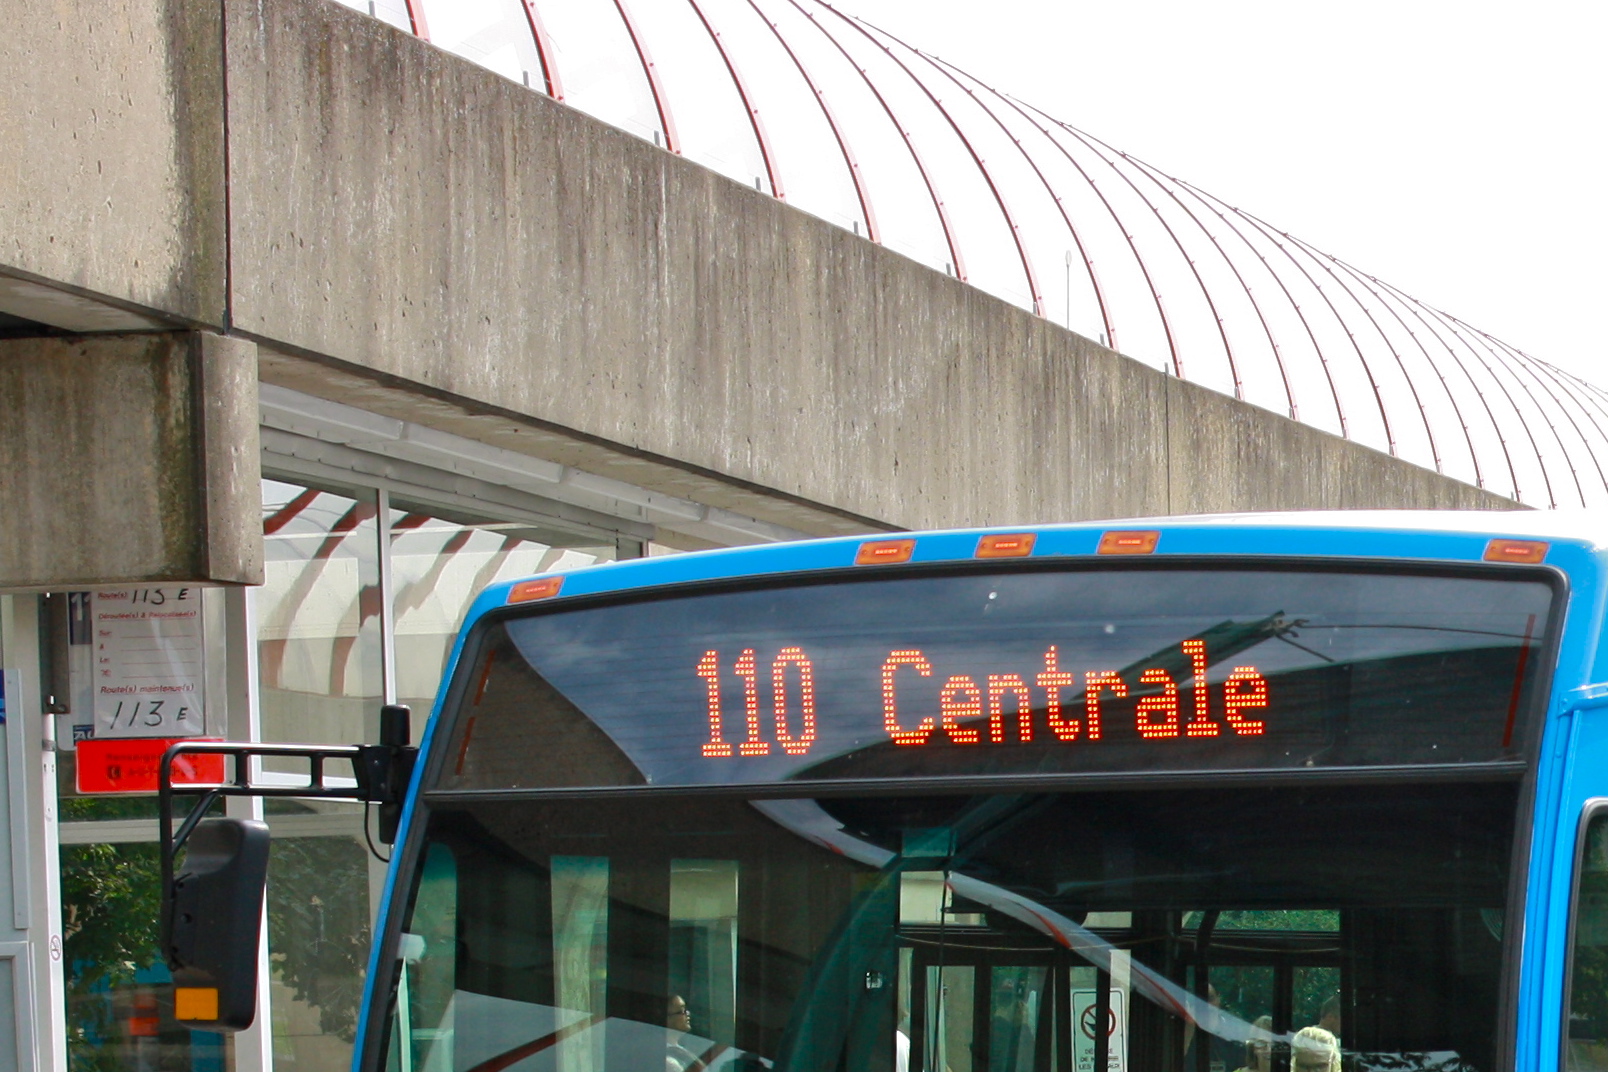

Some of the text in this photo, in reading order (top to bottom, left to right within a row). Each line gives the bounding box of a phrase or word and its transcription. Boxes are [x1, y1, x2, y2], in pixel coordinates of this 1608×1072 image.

[110, 700, 188, 730] 113 E
[696, 638, 1270, 757] 110 Centrale
